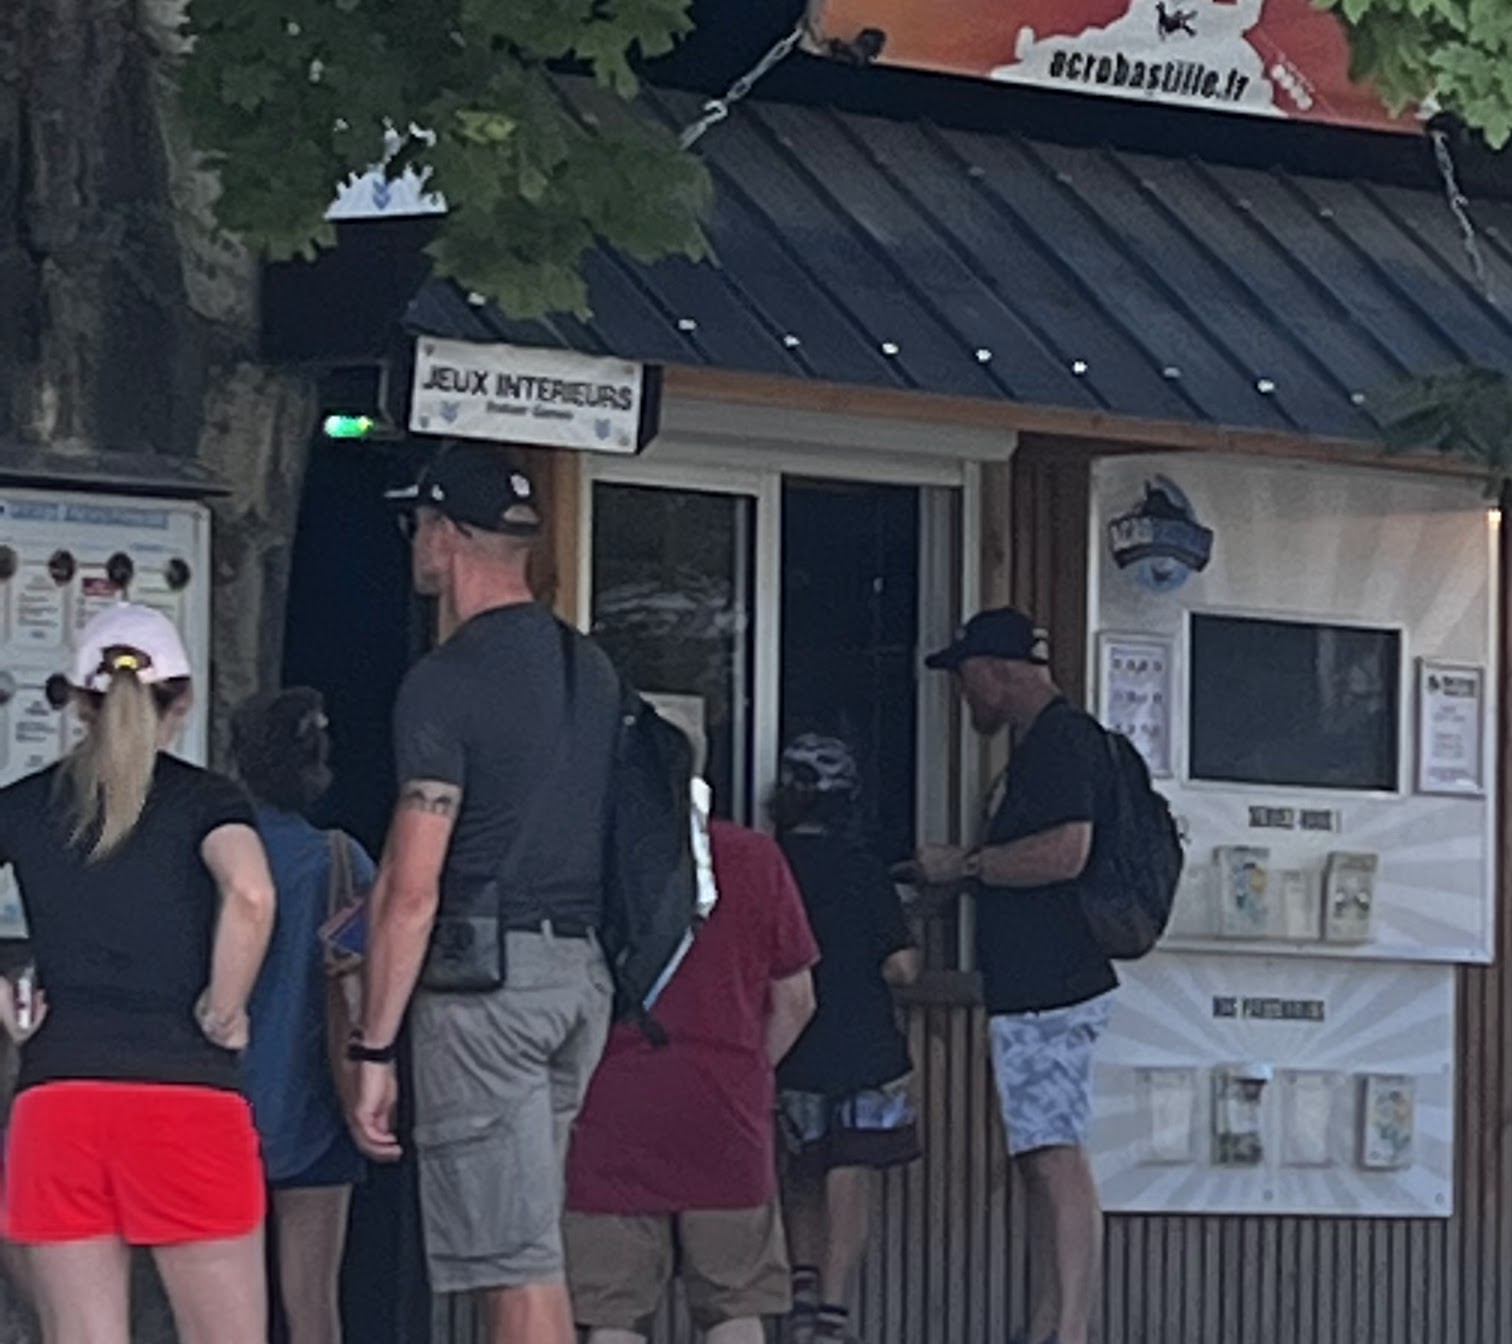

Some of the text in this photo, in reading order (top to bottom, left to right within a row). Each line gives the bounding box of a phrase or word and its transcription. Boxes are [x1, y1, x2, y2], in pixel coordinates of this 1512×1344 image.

[1049, 49, 1250, 102] acrobastille.fr
[422, 364, 634, 411] JEUX INTERIEURS
